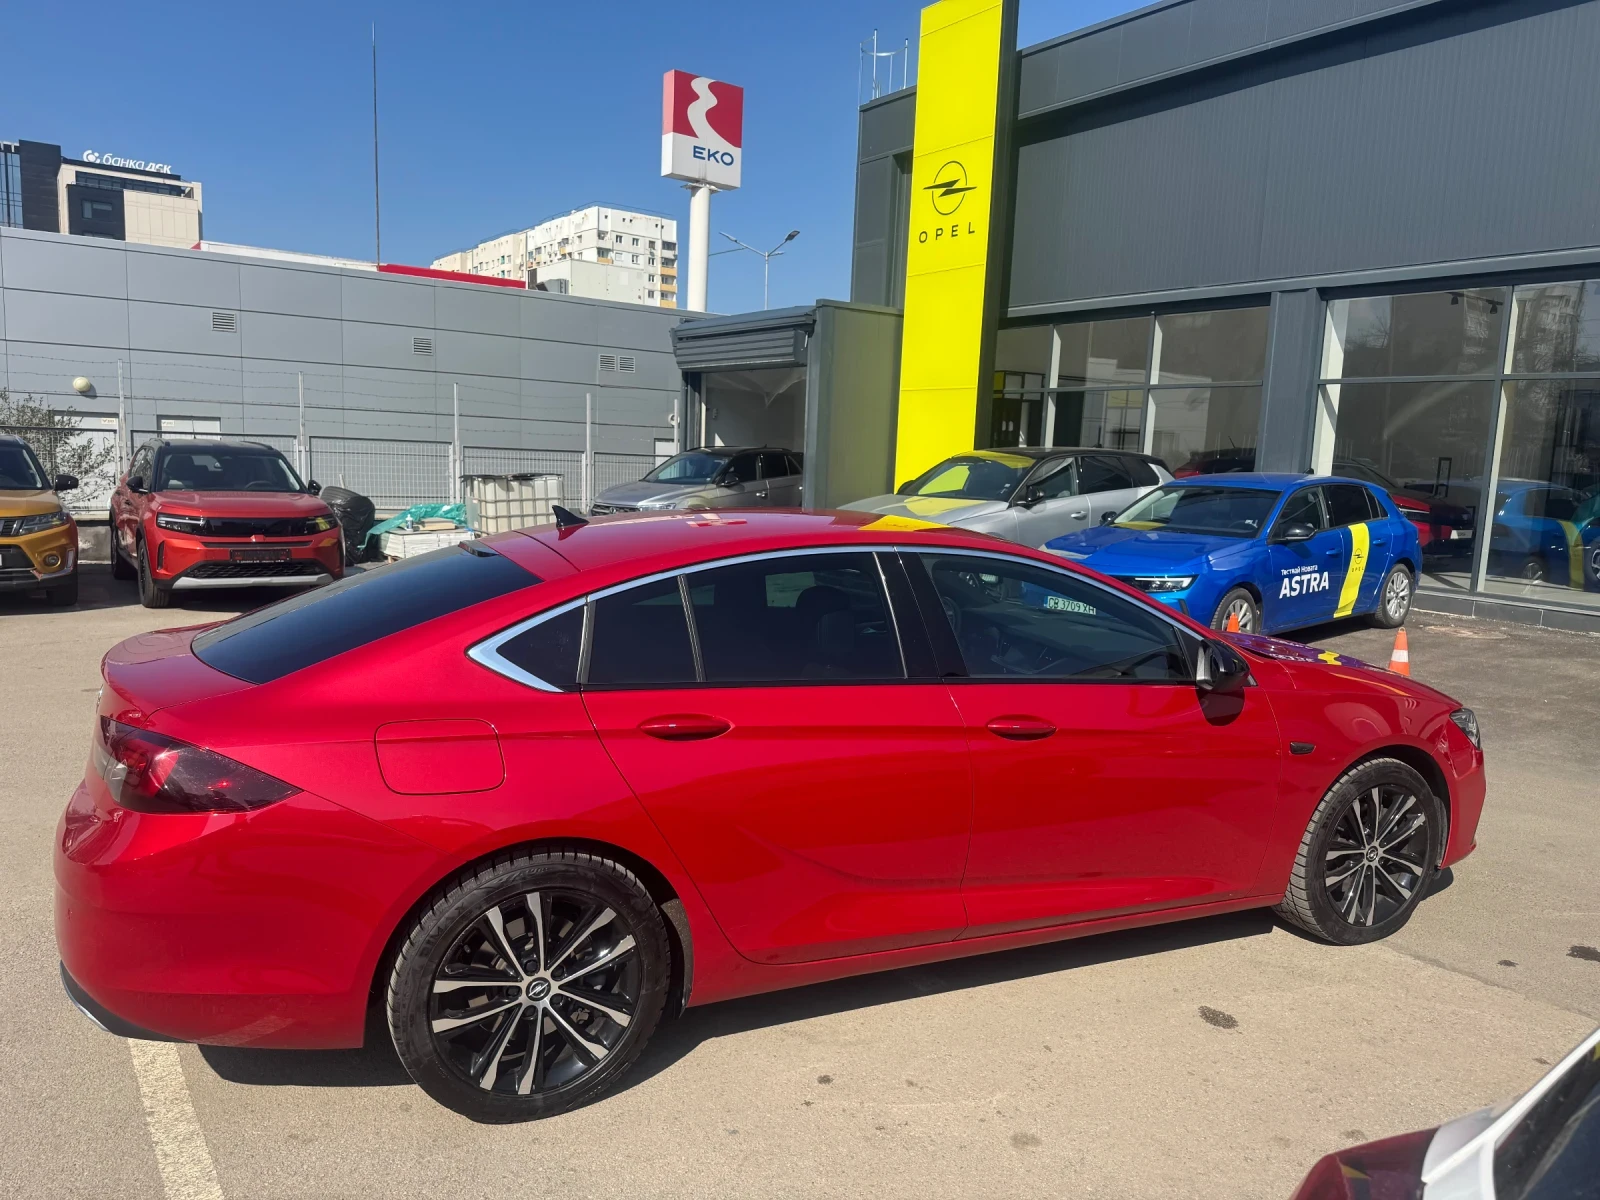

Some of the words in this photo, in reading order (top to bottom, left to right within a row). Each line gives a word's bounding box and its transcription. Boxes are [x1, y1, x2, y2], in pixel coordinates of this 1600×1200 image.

[102, 153, 145, 170] банка
[693, 145, 734, 166] EKO
[918, 221, 975, 244] OPEL
[1279, 571, 1329, 599] ASTRA
[1061, 599, 1081, 612] 3709
